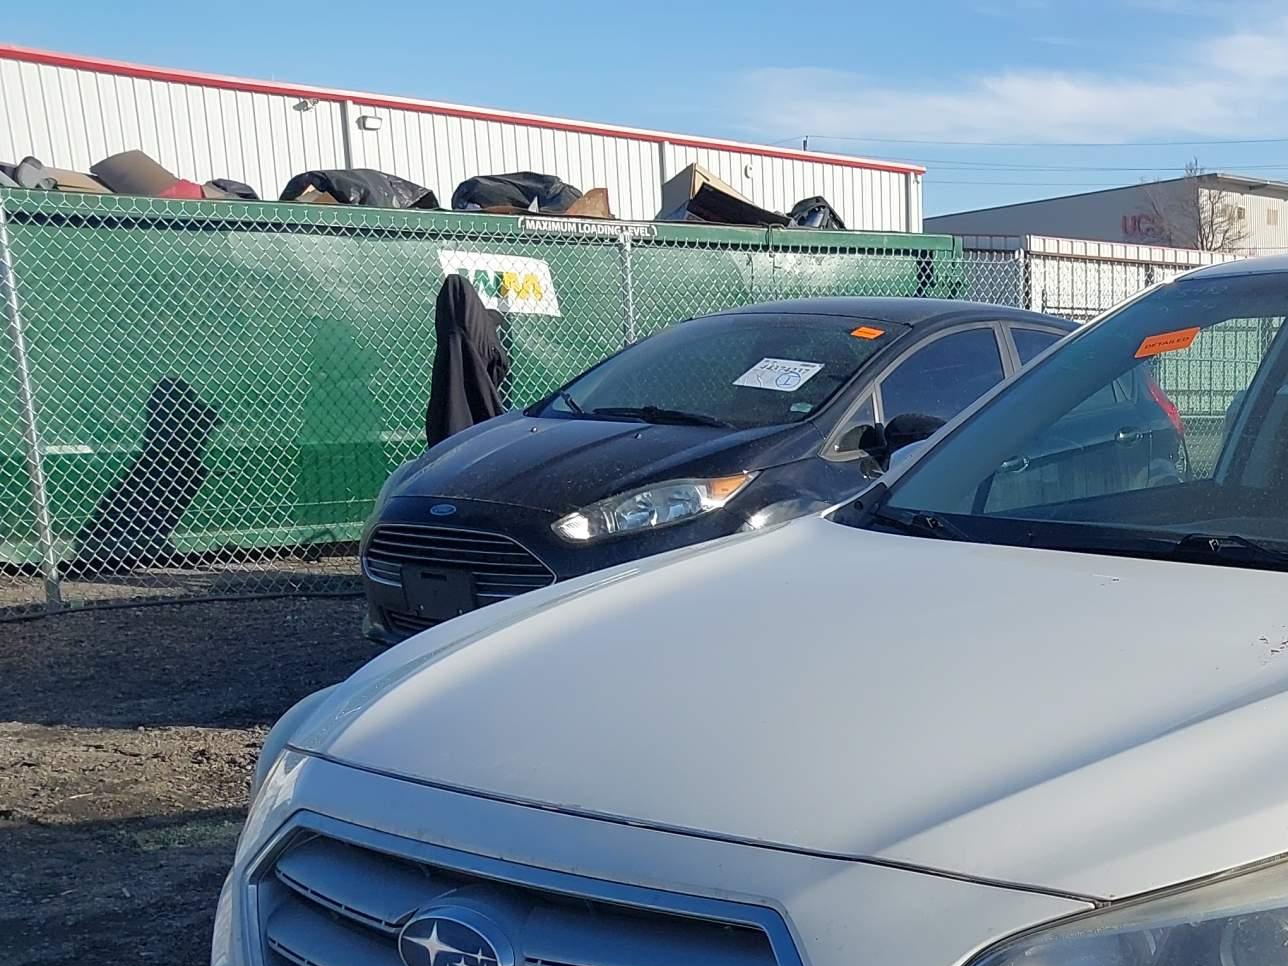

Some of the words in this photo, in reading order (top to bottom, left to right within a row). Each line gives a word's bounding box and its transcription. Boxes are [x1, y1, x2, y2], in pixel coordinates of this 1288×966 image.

[526, 219, 577, 233] MAXIMUM
[578, 223, 621, 235] LOADING
[622, 226, 651, 237] LEVEL
